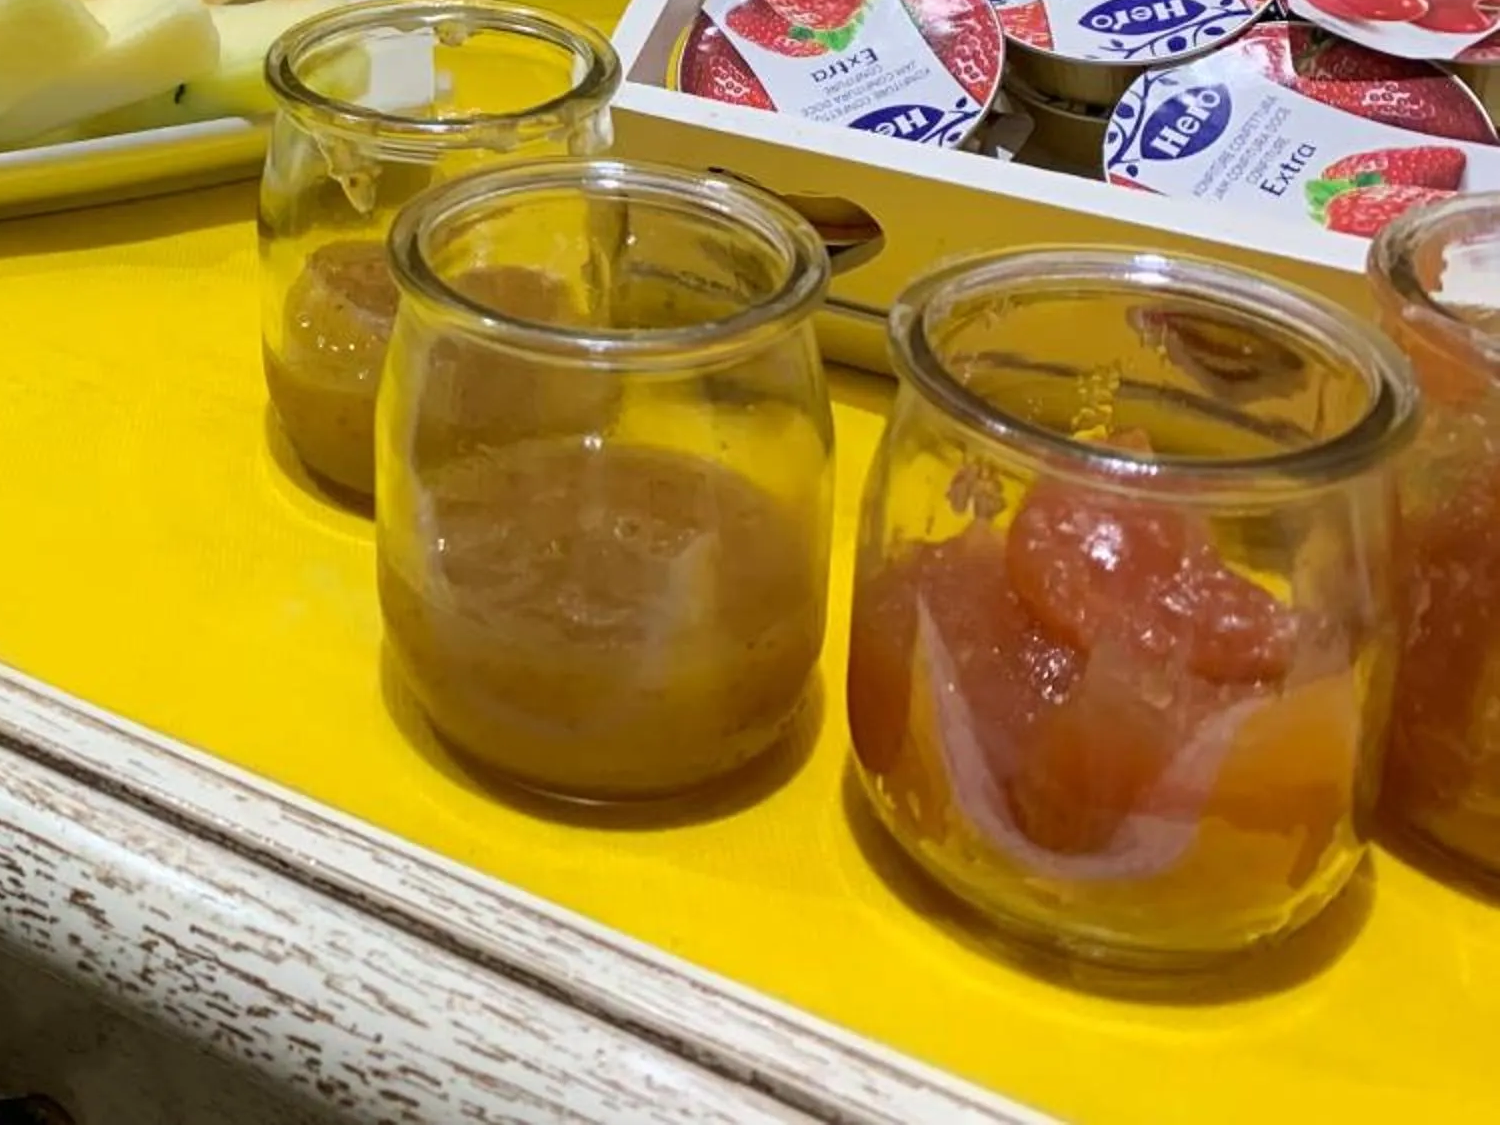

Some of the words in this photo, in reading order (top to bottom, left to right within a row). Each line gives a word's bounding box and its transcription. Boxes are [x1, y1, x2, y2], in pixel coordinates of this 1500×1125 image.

[811, 46, 879, 84] Extra
[875, 108, 928, 138] He
[1151, 88, 1223, 159] Hero
[1259, 142, 1317, 197] Extra
